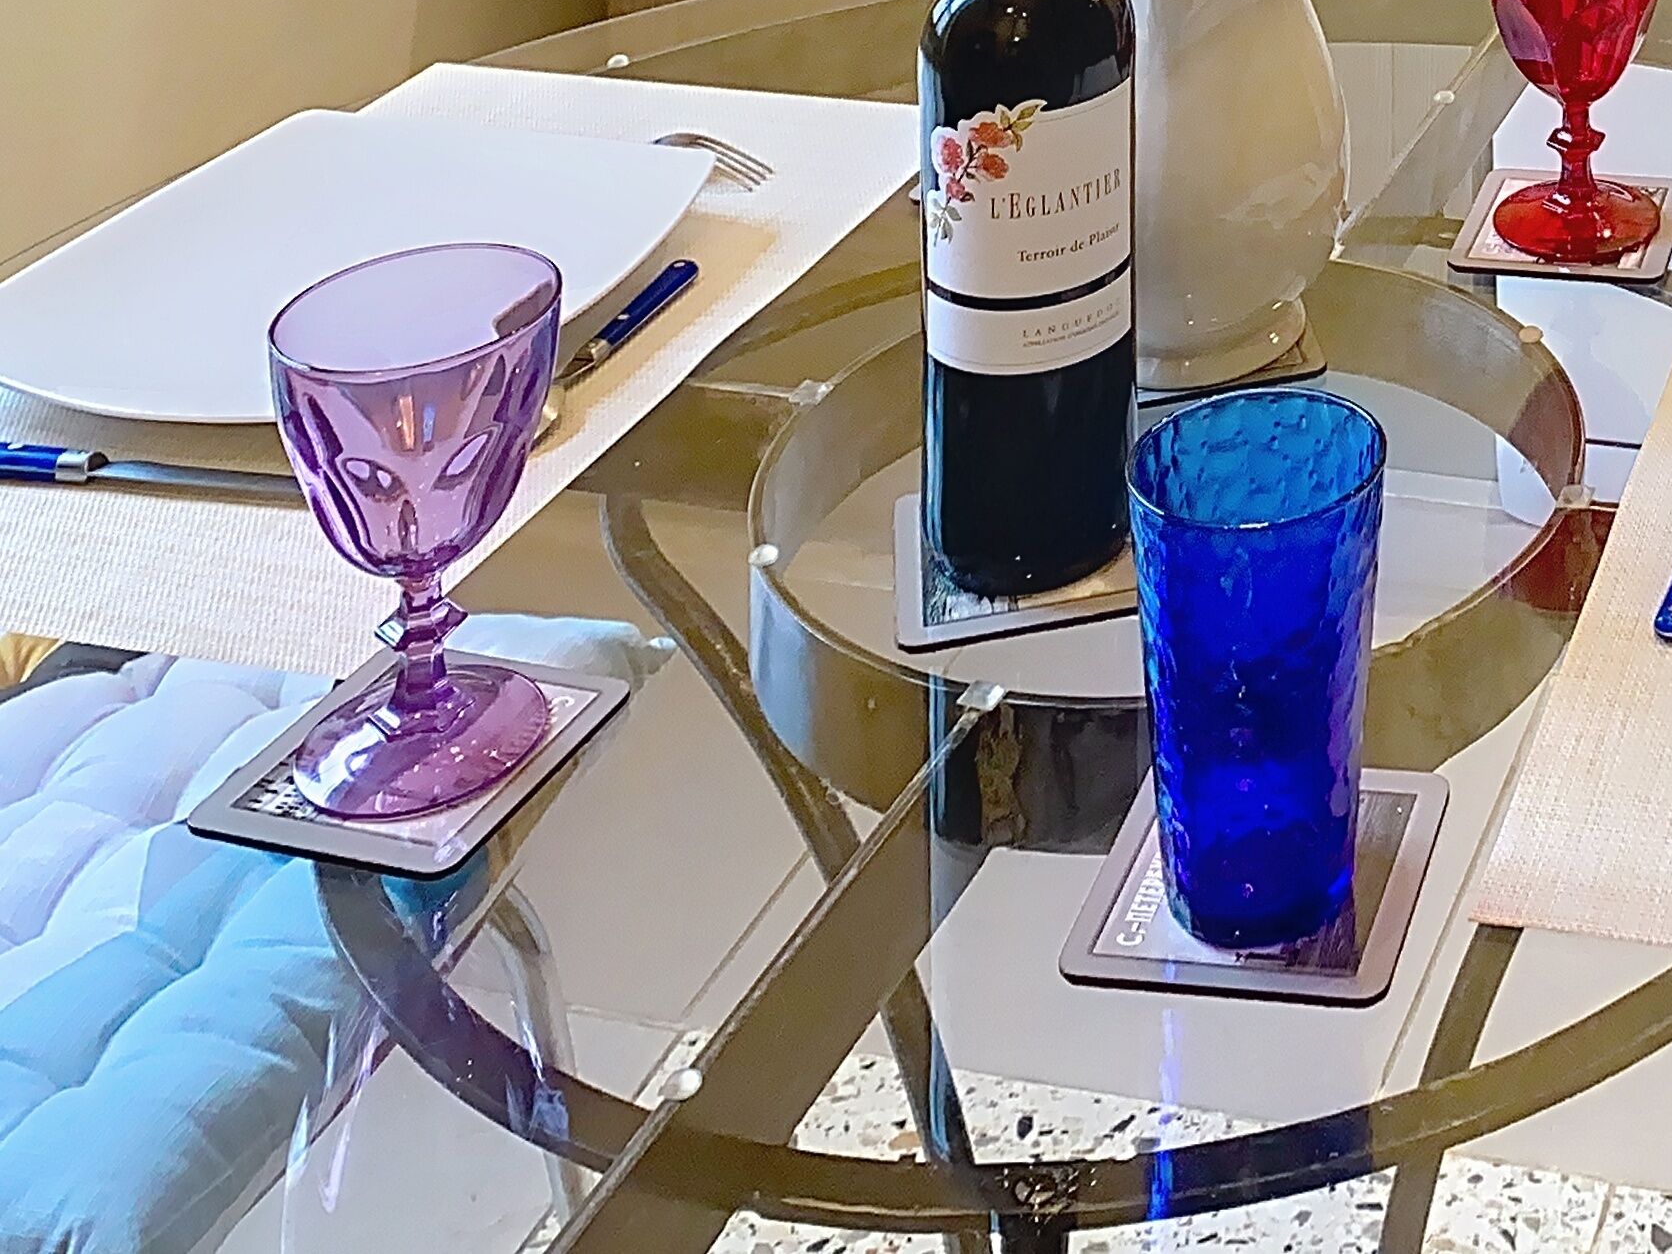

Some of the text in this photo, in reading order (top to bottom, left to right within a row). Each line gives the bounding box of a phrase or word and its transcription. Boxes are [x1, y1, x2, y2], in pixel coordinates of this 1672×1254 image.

[1017, 223, 1120, 262] Terroir de Plaisir
